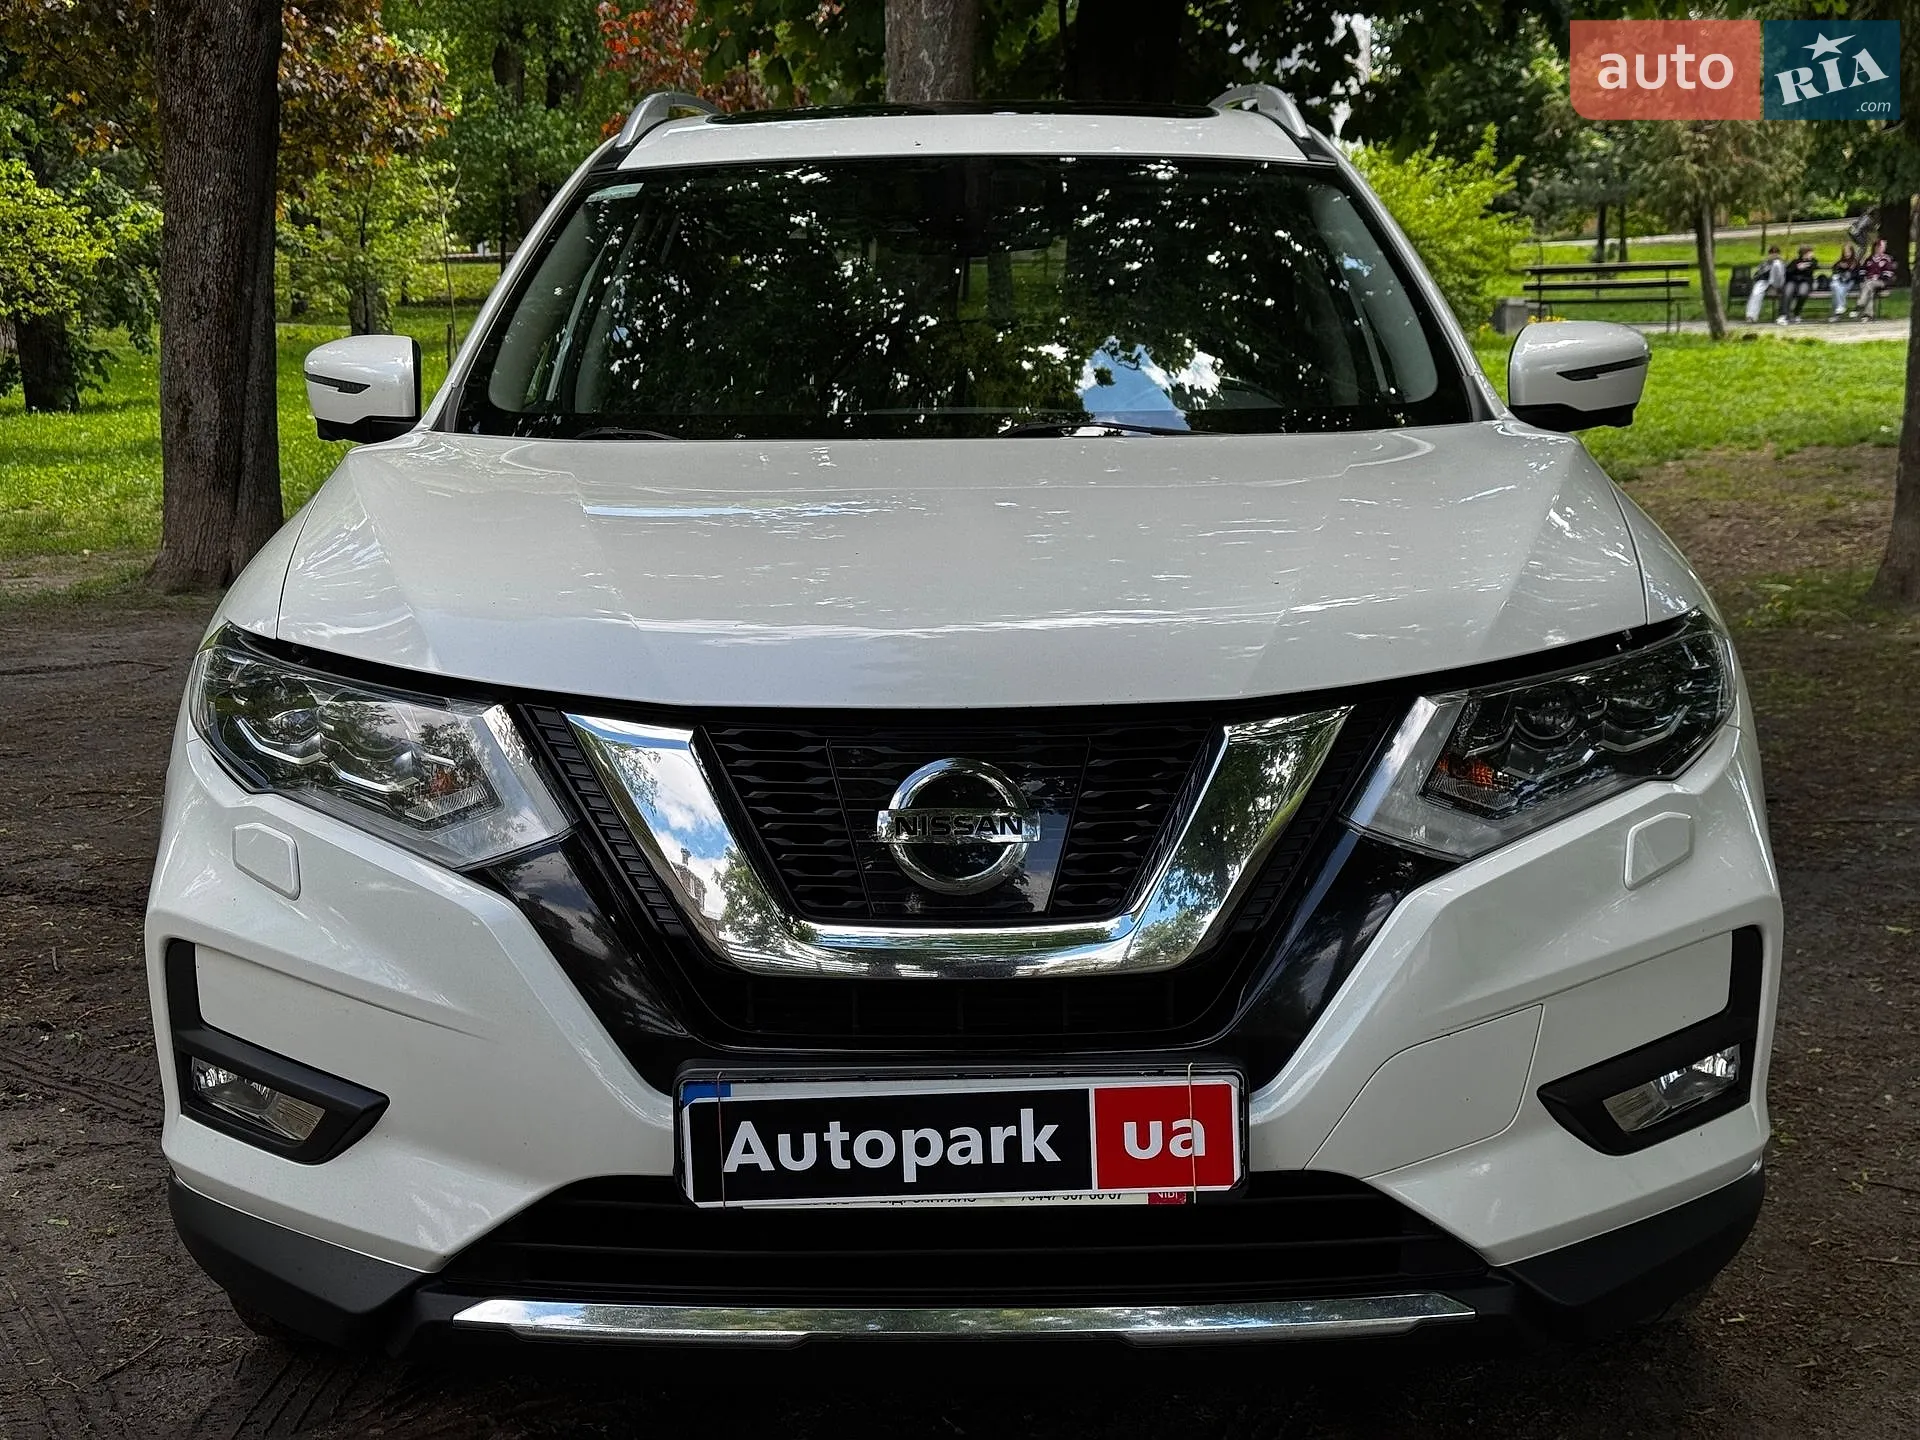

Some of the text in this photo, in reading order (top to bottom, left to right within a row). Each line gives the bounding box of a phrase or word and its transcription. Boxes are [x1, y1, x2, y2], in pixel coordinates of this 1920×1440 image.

[894, 815, 1024, 836] NISSAN
[723, 1108, 1206, 1184] Autopark ua
